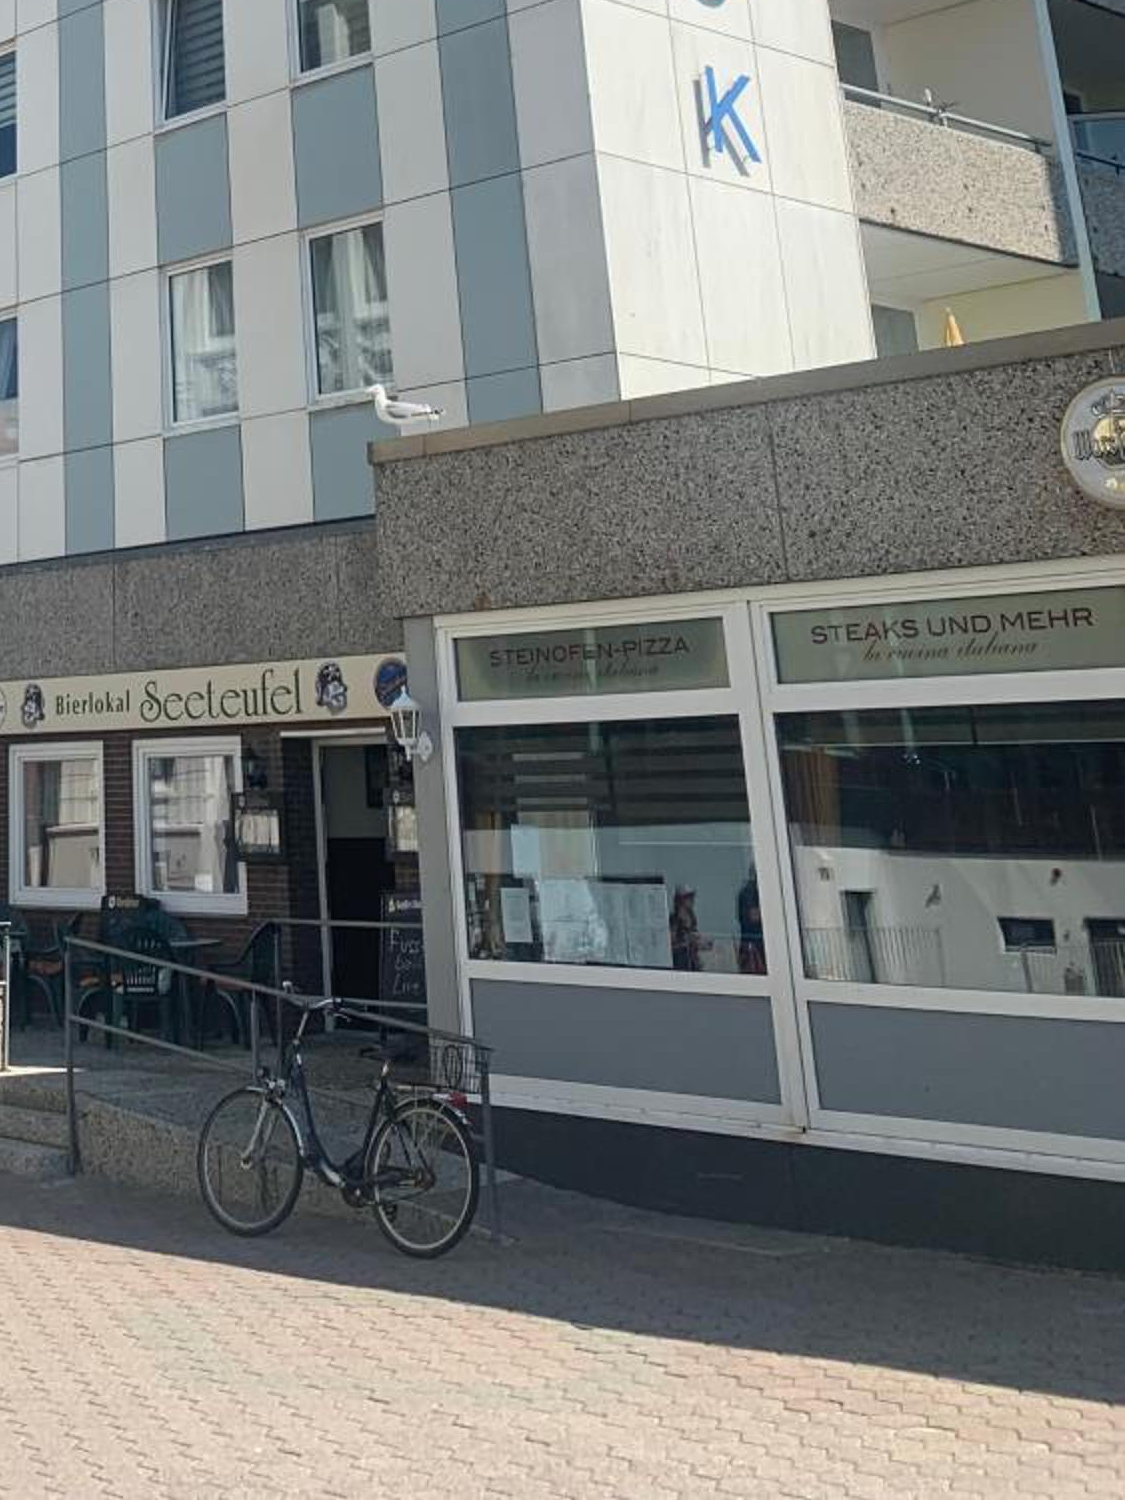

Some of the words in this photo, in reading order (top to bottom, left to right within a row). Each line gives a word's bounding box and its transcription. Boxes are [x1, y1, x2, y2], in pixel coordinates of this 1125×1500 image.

[810, 618, 920, 645] STEAKS
[926, 613, 992, 638] UND
[999, 606, 1095, 633] MEHR
[489, 635, 690, 668] STEINOFEN-PIZZA
[55, 688, 131, 716] Bierlokal
[139, 667, 303, 723] Seeteufel
